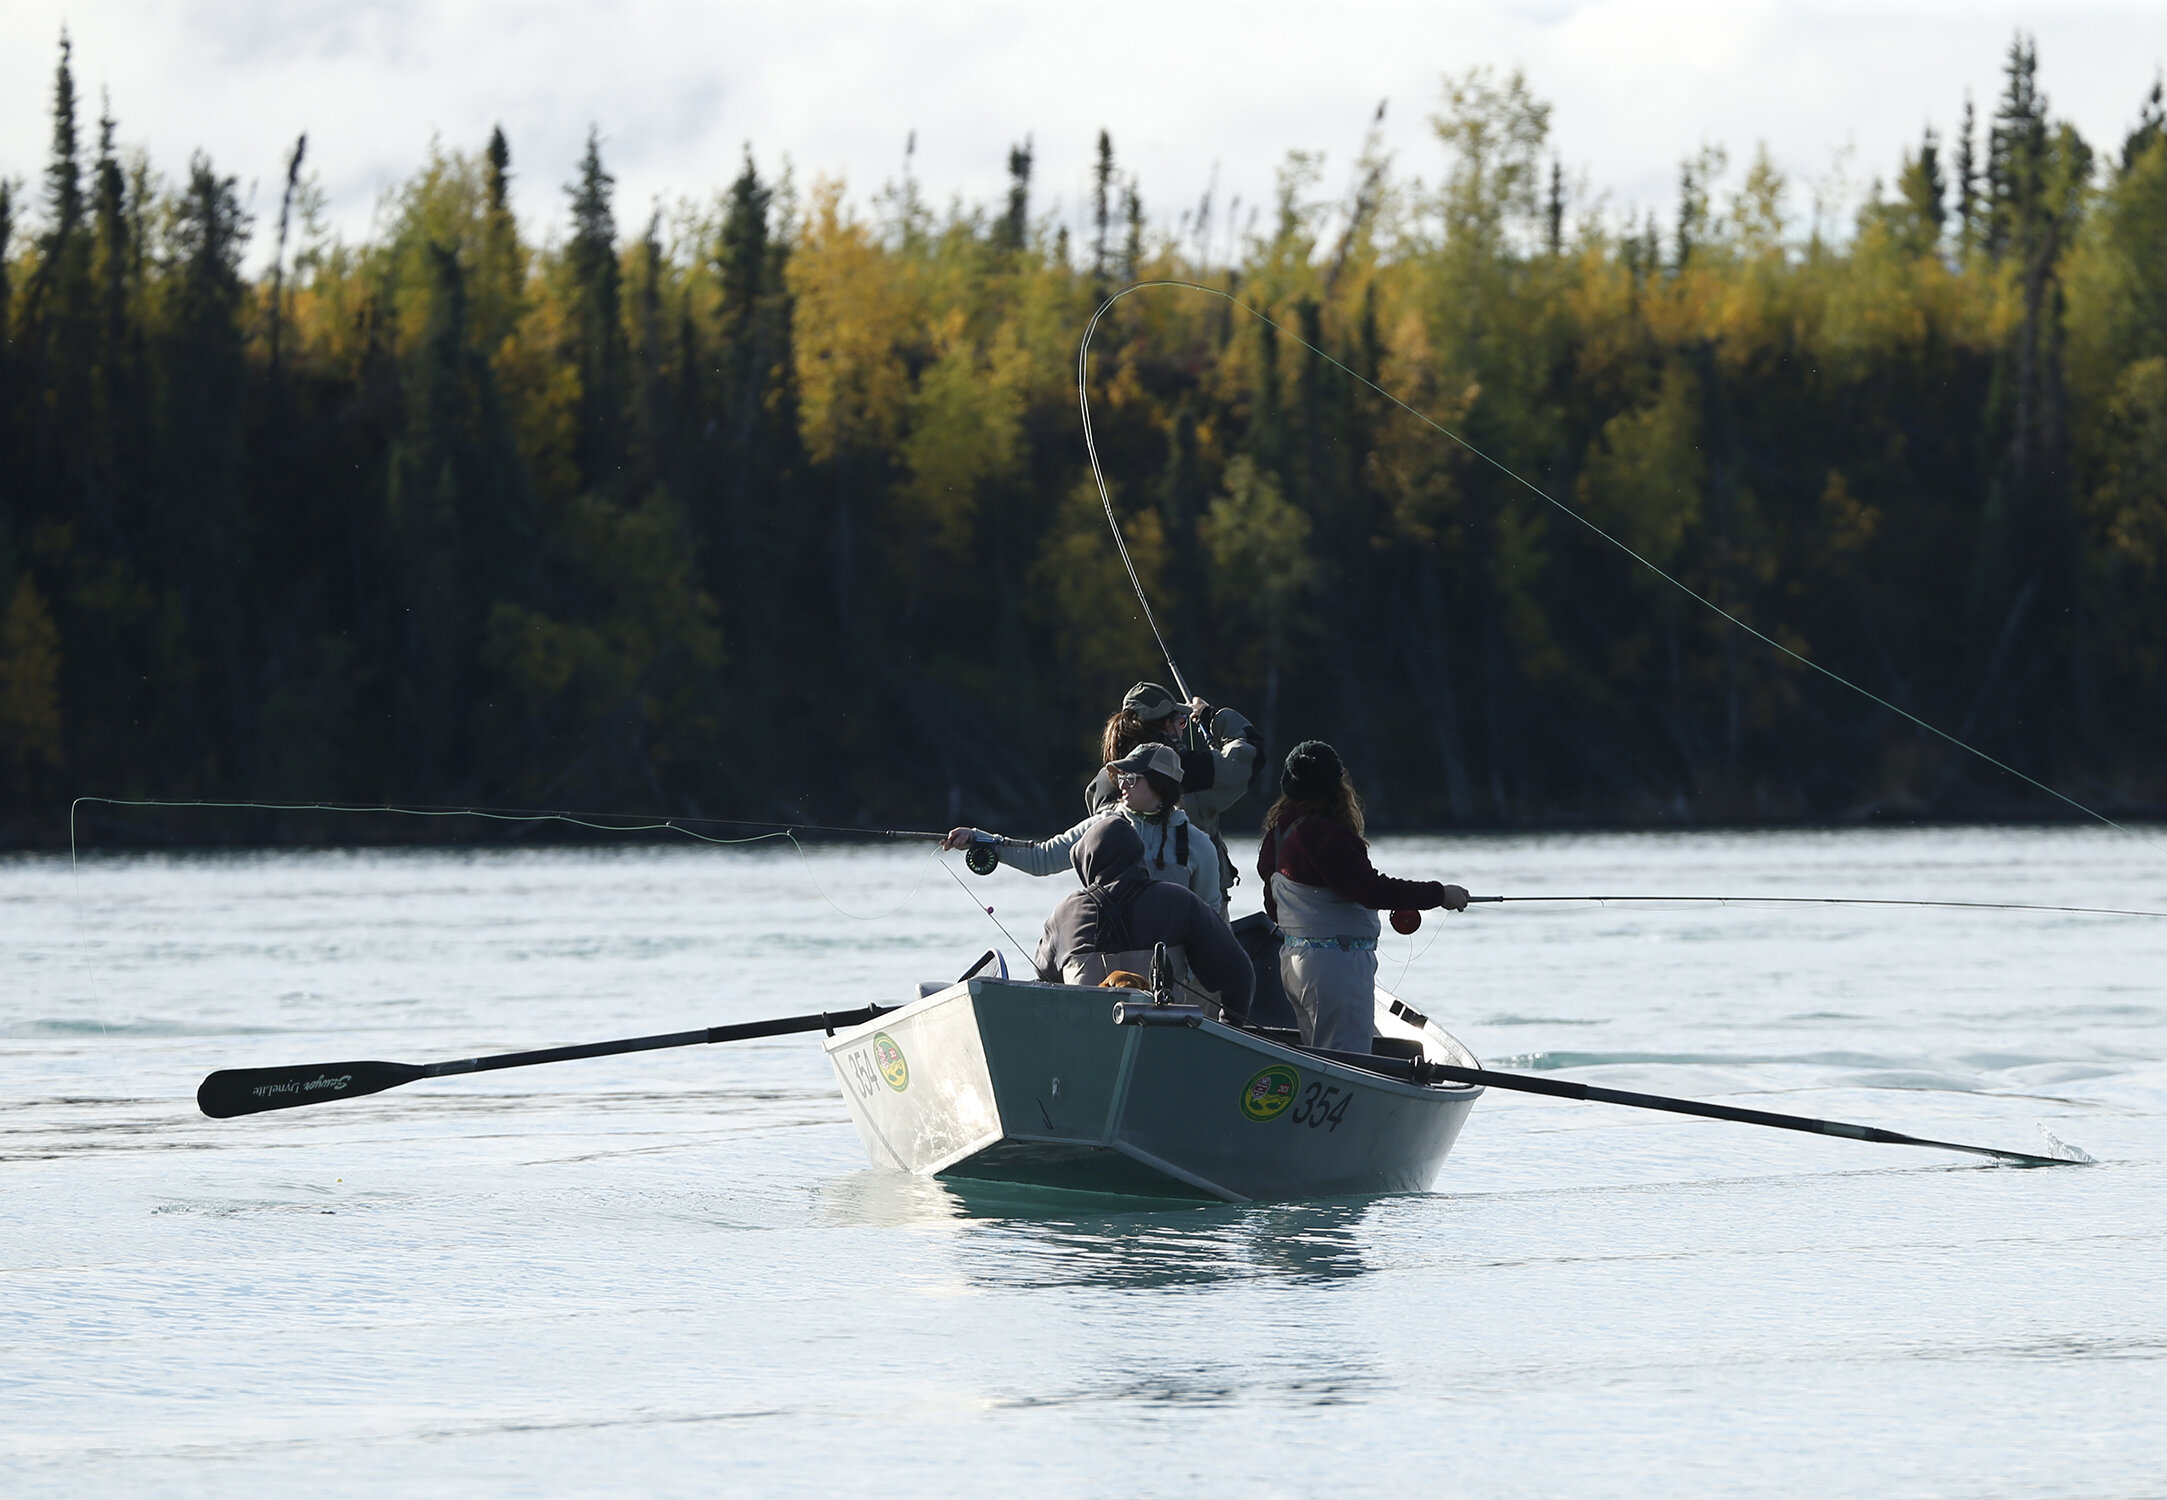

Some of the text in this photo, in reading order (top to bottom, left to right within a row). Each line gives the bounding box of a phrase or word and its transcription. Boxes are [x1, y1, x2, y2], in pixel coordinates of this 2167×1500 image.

[304, 1074, 352, 1091] Sawyer
[848, 1048, 880, 1099] 354
[1292, 1081, 1354, 1133] 354
